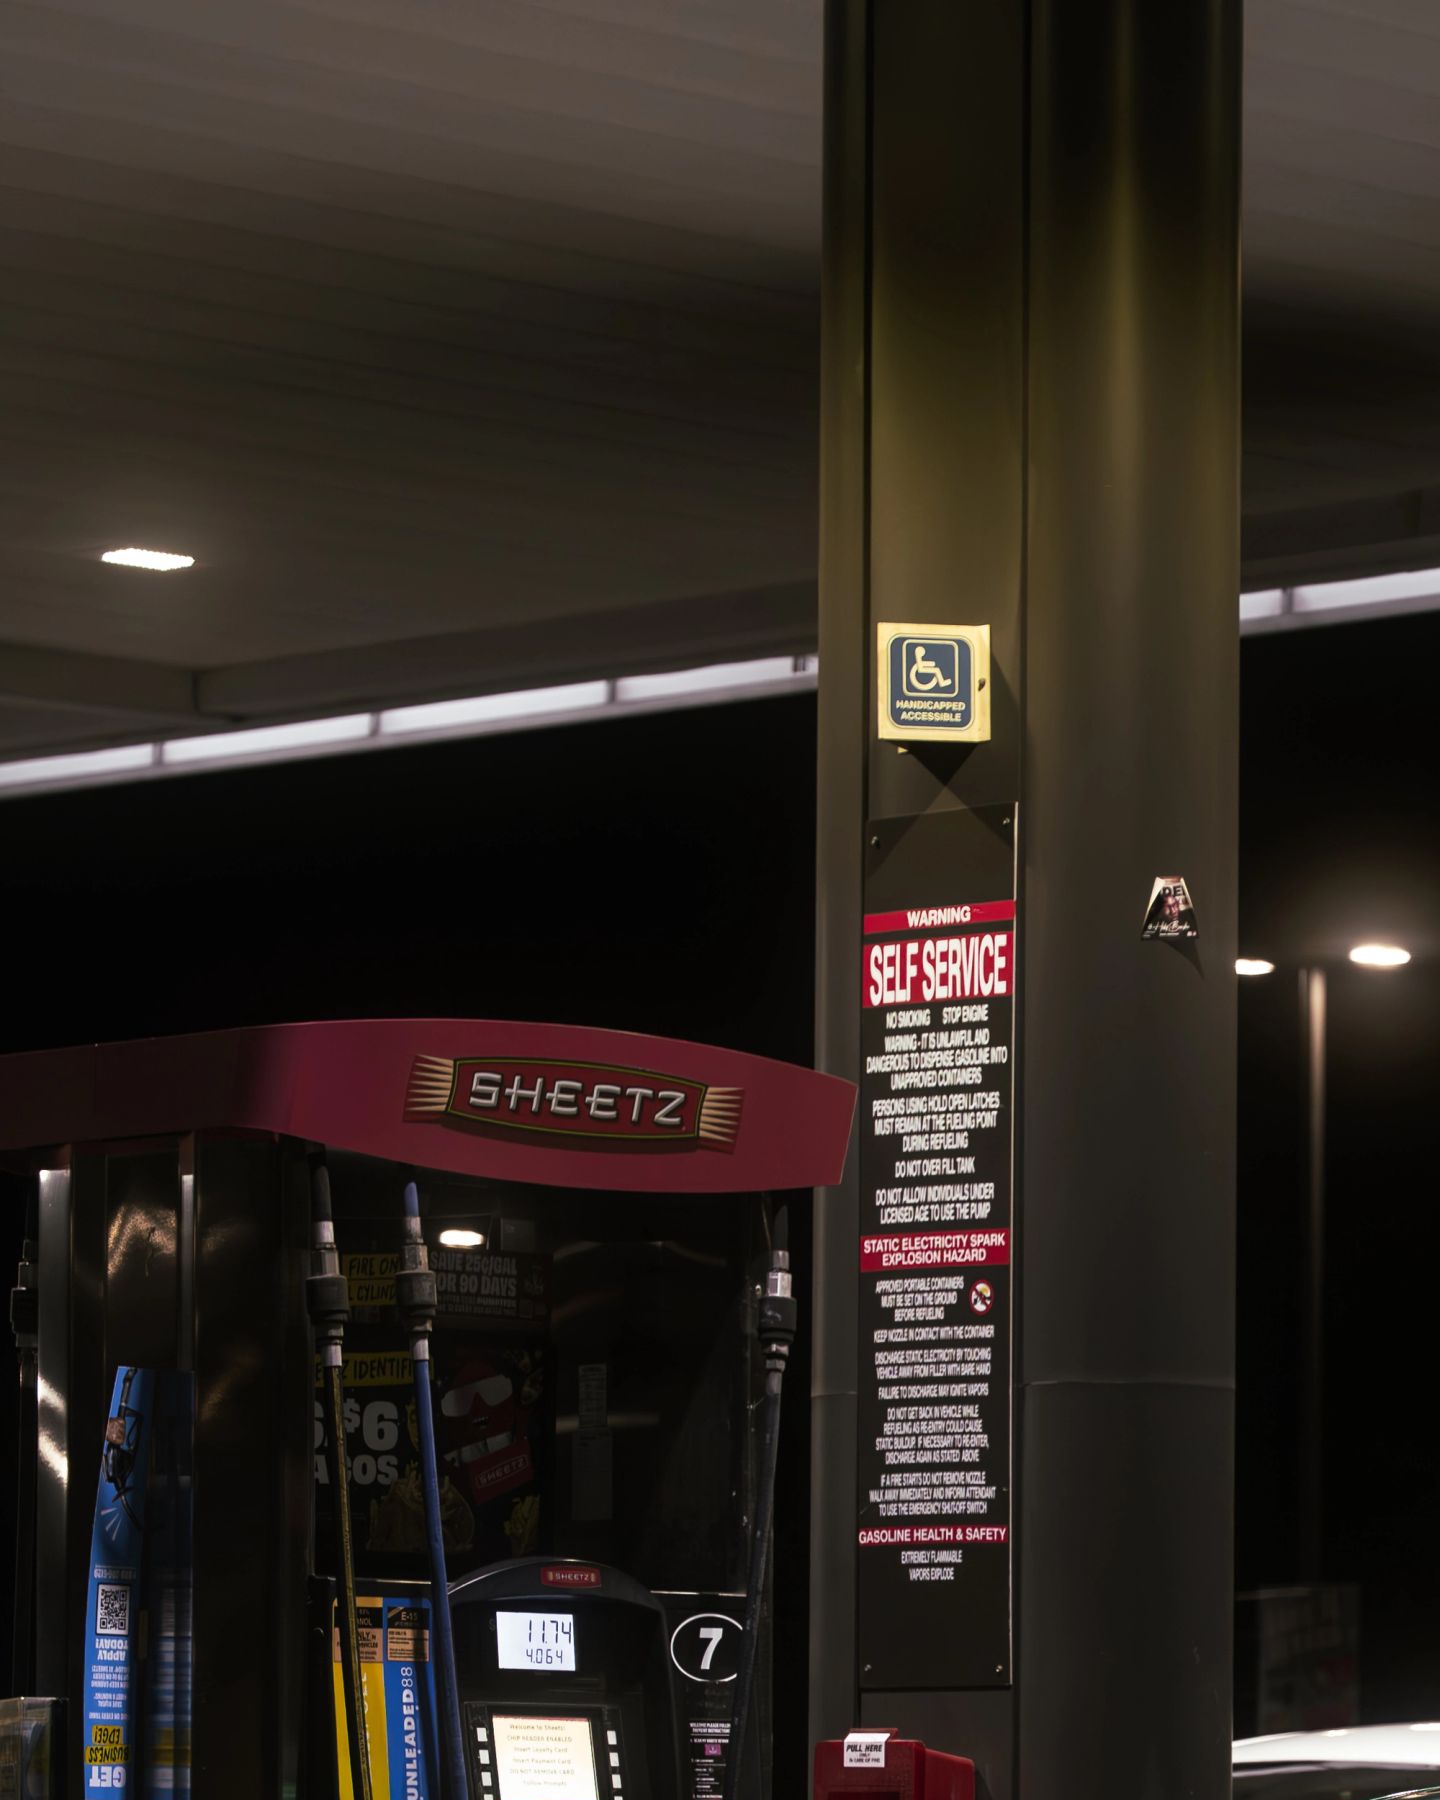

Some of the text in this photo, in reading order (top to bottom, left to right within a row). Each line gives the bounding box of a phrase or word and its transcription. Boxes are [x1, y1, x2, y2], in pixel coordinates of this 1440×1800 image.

[896, 700, 966, 711] HANDICAPPED
[901, 711, 962, 722] ACCESSIBLE
[907, 906, 971, 928] WARNING
[870, 934, 1007, 1006] SELF SERVICE
[886, 1004, 988, 1029] NO SMOKING STOP ENGINE
[884, 1028, 990, 1052] WARNING IT IS UNLAWFUL AND
[866, 1046, 1007, 1074] DANGEROUS TO DISPENSE GASOLINE INTO
[891, 1067, 982, 1090] UNAPPROVED CONTAINERS
[469, 1072, 686, 1126] SHEETZ
[873, 1092, 1000, 1117] PERSONS USING HOLD OPEN LATCHES
[875, 1111, 998, 1136] MUST REMAIN AT THE FUELING POINT
[903, 1131, 968, 1152] DURING REFUELING
[895, 1156, 975, 1178] DO NOT OVER FILL TANK
[876, 1183, 994, 1206] DO NOT ALLOW INDIVIDUALS UNDER
[881, 1202, 991, 1224] LICENSED AGE TO USE THE PUMP
[864, 1233, 1005, 1253] STATIC ELECTRICITY SPARK
[350, 1255, 375, 1275] FIRE
[431, 1251, 462, 1271] SAVE
[882, 1249, 986, 1266] EXPLOSION HAZARD
[460, 1277, 479, 1293] 90
[481, 1280, 517, 1297] DAYS
[353, 1358, 412, 1378] IDENTIFI
[859, 1527, 1006, 1544] GASOLINE HEALTH & SAFETY
[555, 1573, 589, 1581] SHEETZ
[528, 1620, 572, 1644] 11.74
[98, 1651, 125, 1661] APPLY
[526, 1649, 563, 1664] 4.064
[699, 1628, 723, 1670] 7
[95, 1727, 120, 1744] EDGE!
[89, 1748, 128, 1763] BUSINESS
[89, 1766, 126, 1787] GET
